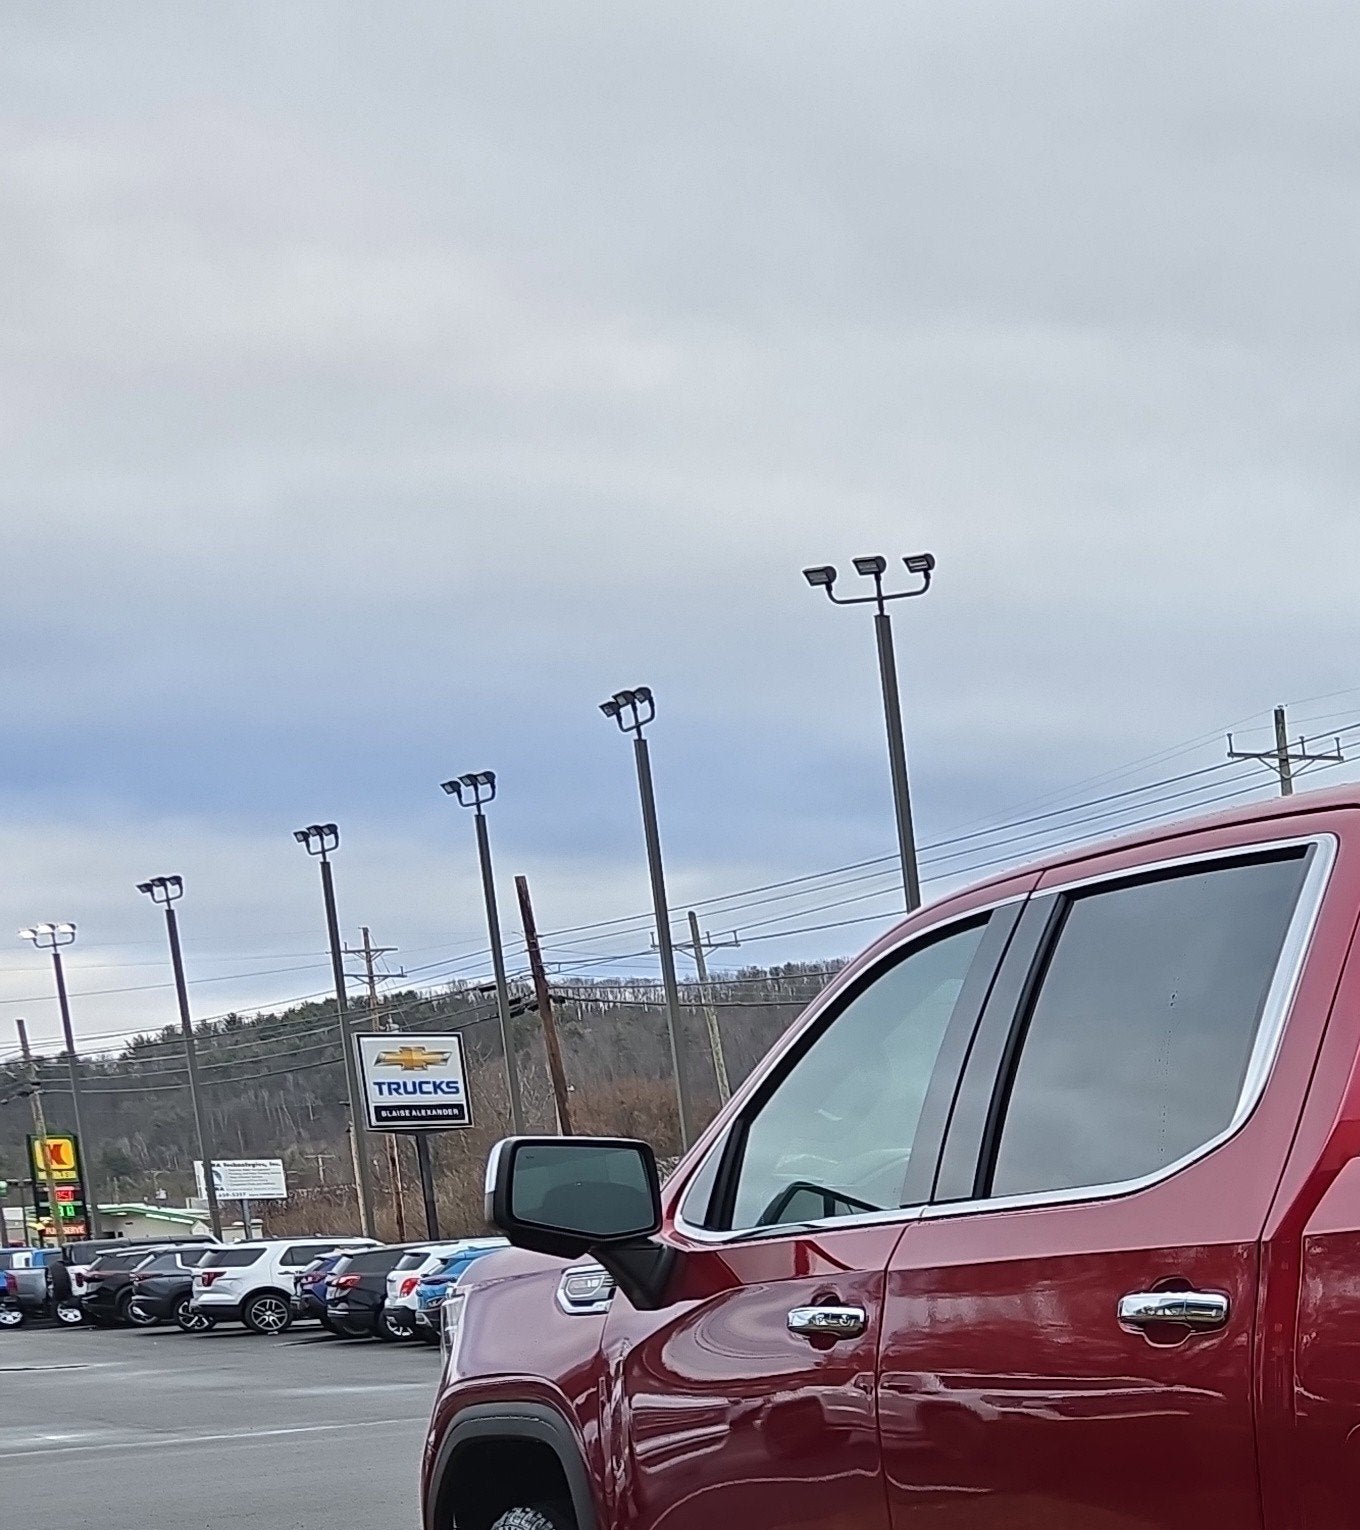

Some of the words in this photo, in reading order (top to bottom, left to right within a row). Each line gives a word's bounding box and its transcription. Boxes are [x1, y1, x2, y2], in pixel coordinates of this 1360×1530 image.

[372, 1080, 460, 1096] TRUCKS
[381, 1108, 410, 1118] BLAISE
[411, 1108, 459, 1117] ALEXANDER
